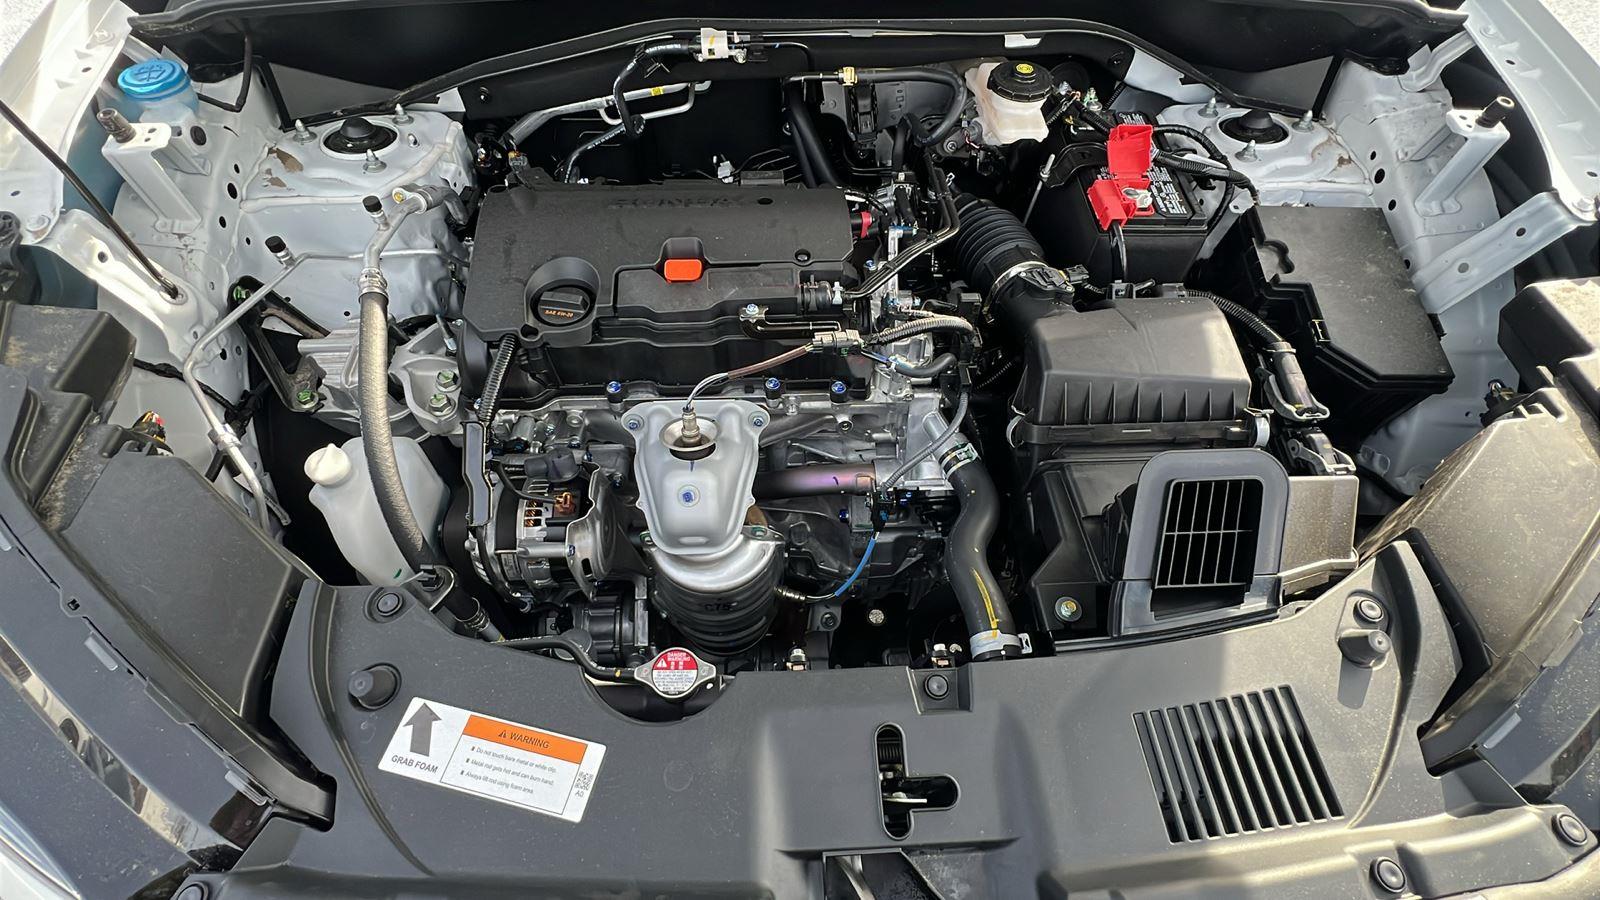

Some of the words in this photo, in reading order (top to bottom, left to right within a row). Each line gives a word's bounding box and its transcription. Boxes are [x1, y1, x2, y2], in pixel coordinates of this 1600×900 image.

[510, 732, 550, 749] WARNING
[391, 755, 414, 767] GRAB
[414, 761, 438, 773] FOAM
[471, 759, 484, 767] Metal
[465, 771, 481, 781] Always
